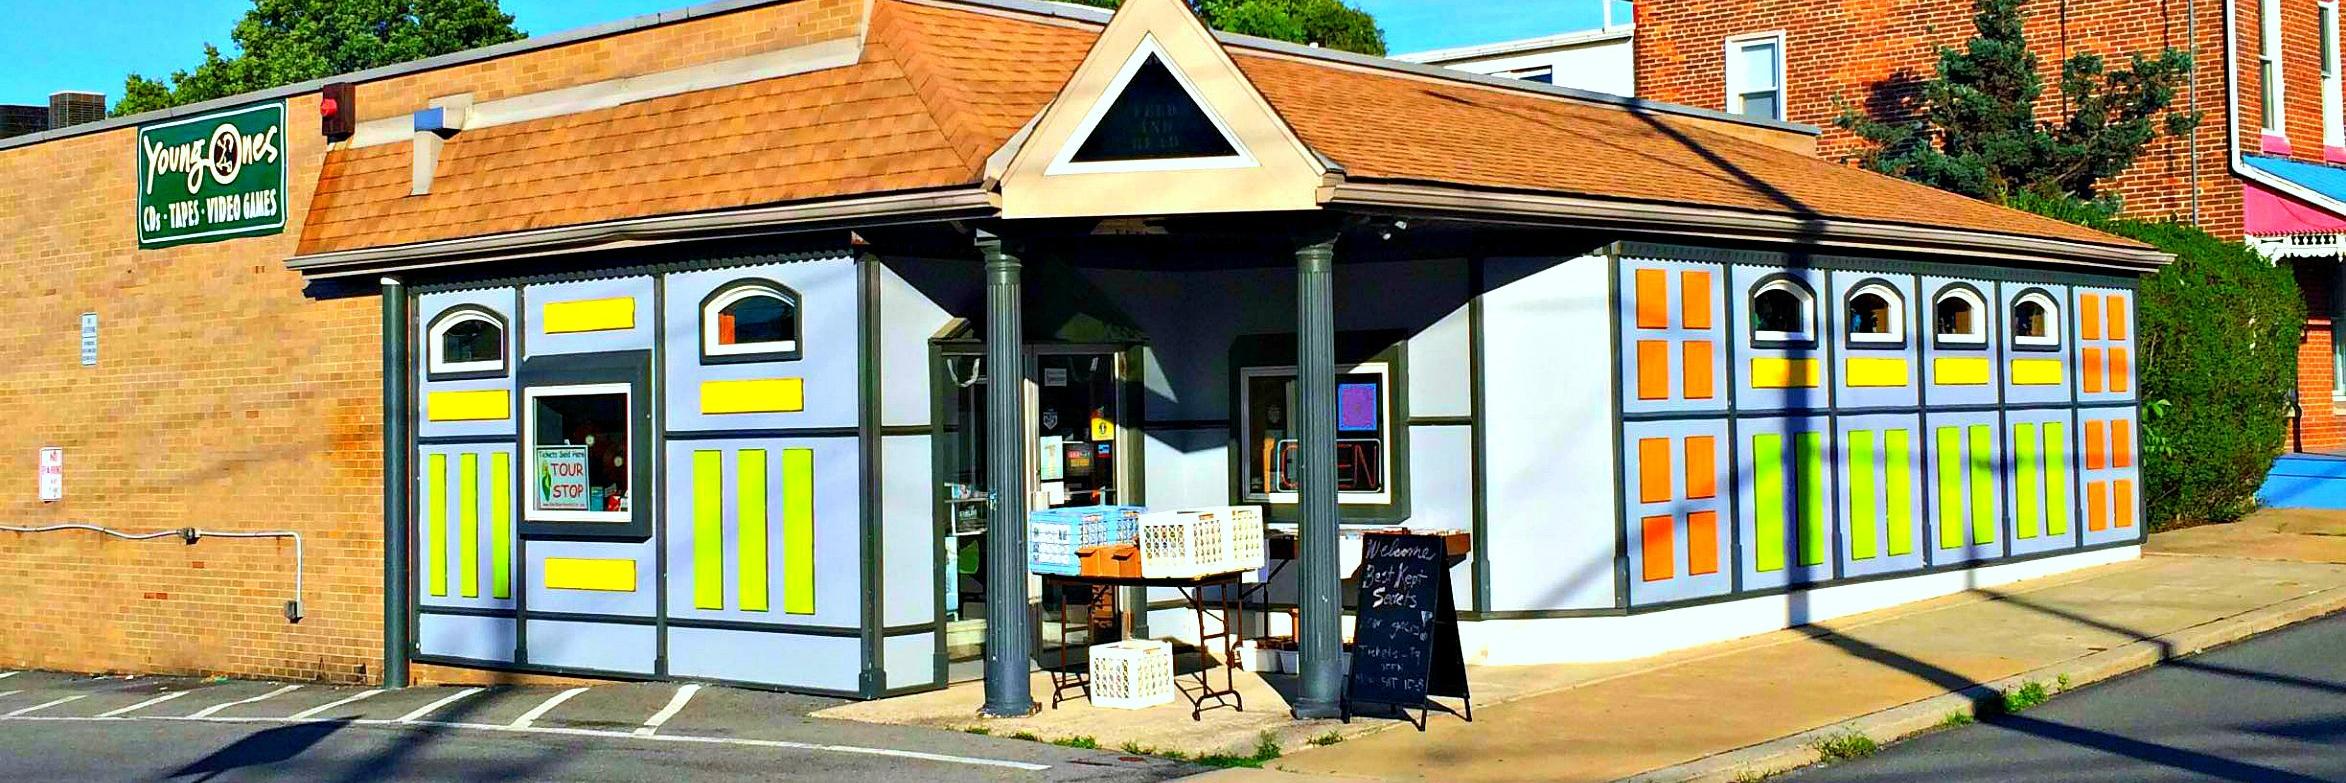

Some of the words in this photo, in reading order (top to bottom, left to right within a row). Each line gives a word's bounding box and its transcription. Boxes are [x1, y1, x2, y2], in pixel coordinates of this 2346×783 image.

[143, 134, 206, 195] Young
[209, 123, 278, 185] Ones
[143, 206, 161, 232] CDs
[168, 200, 200, 229] TAPES
[206, 194, 241, 223] VIDEO
[243, 188, 277, 219] GAMES
[550, 463, 583, 477] TOUR
[1281, 443, 1377, 489] OEN
[553, 484, 584, 498] STOP
[1365, 538, 1437, 561] Welcome
[1362, 564, 1395, 588] Best
[1393, 562, 1428, 588] Kept
[1372, 587, 1417, 608] Secrets
